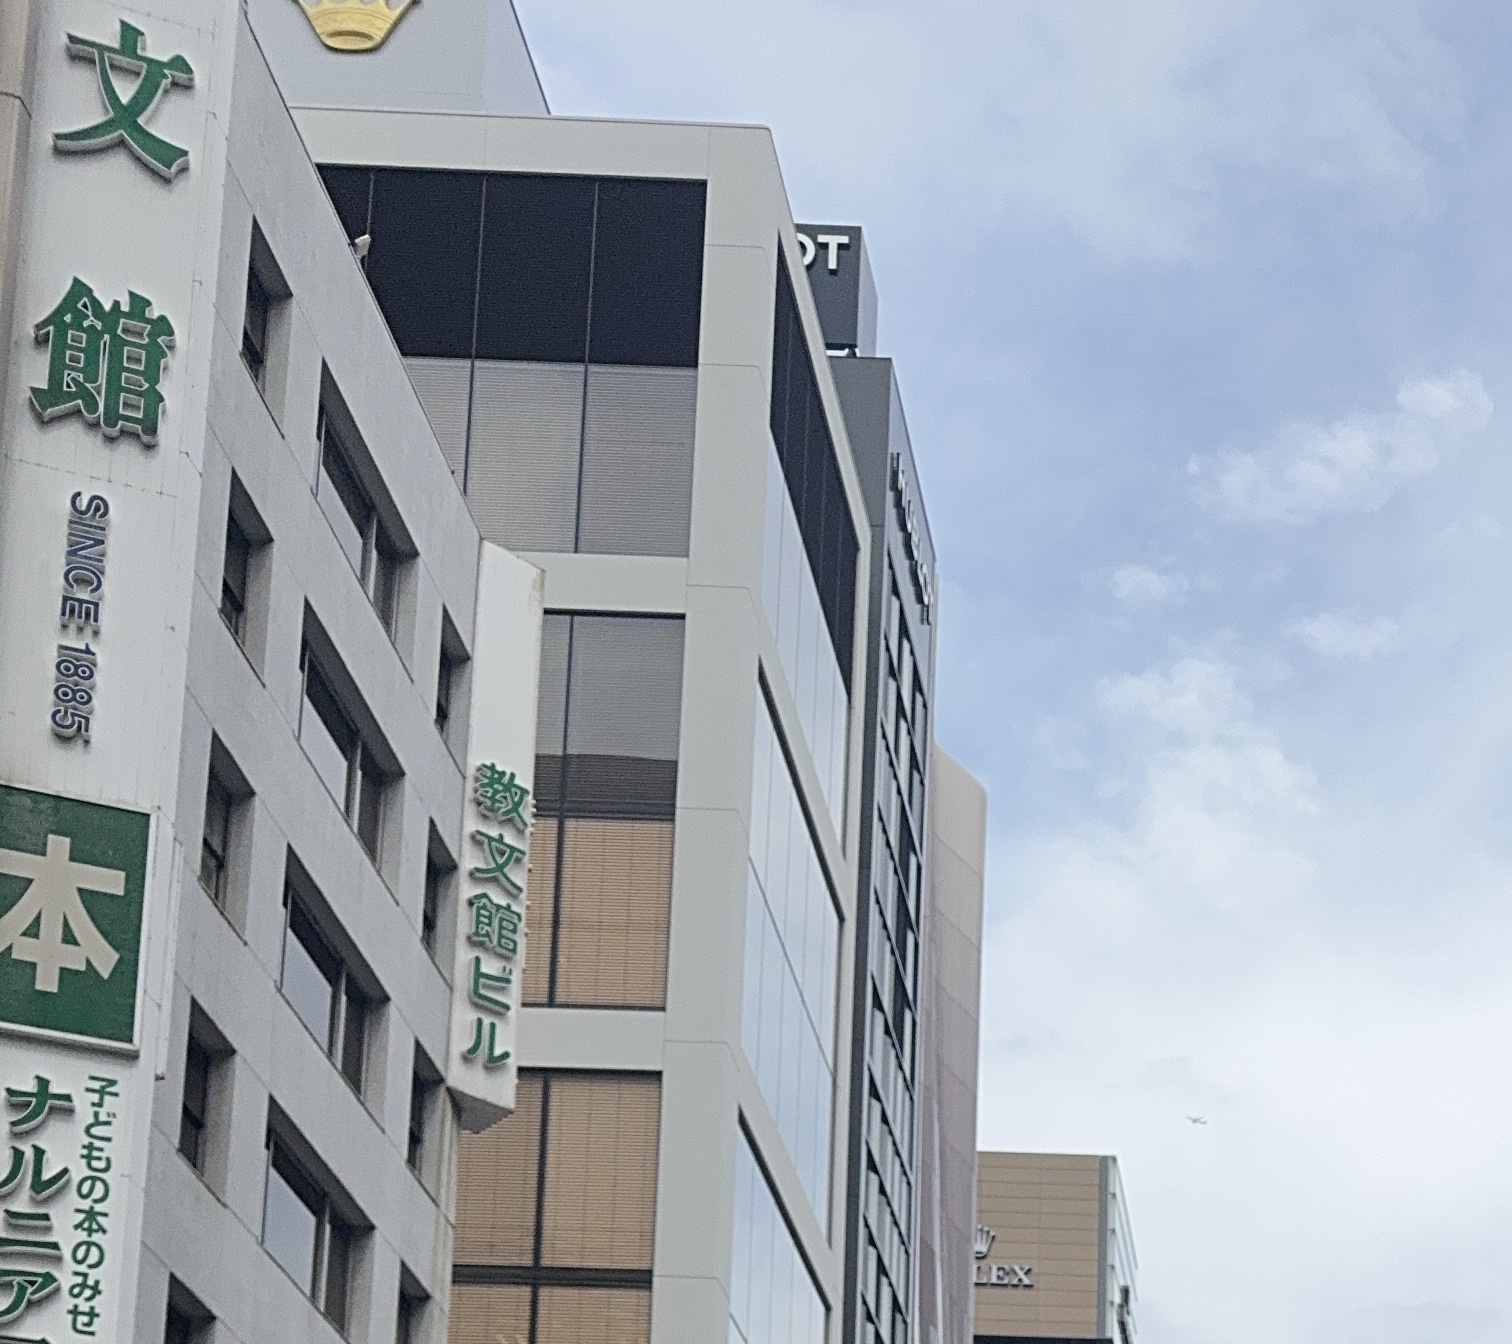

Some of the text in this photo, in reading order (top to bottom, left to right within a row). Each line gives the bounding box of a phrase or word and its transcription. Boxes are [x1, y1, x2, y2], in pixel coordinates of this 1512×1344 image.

[50, 489, 111, 745] SINCE 1885
[0, 834, 126, 993] 本
[464, 761, 529, 1069] 教文館ビル
[66, 1074, 120, 1337] 子どもの本のみせ
